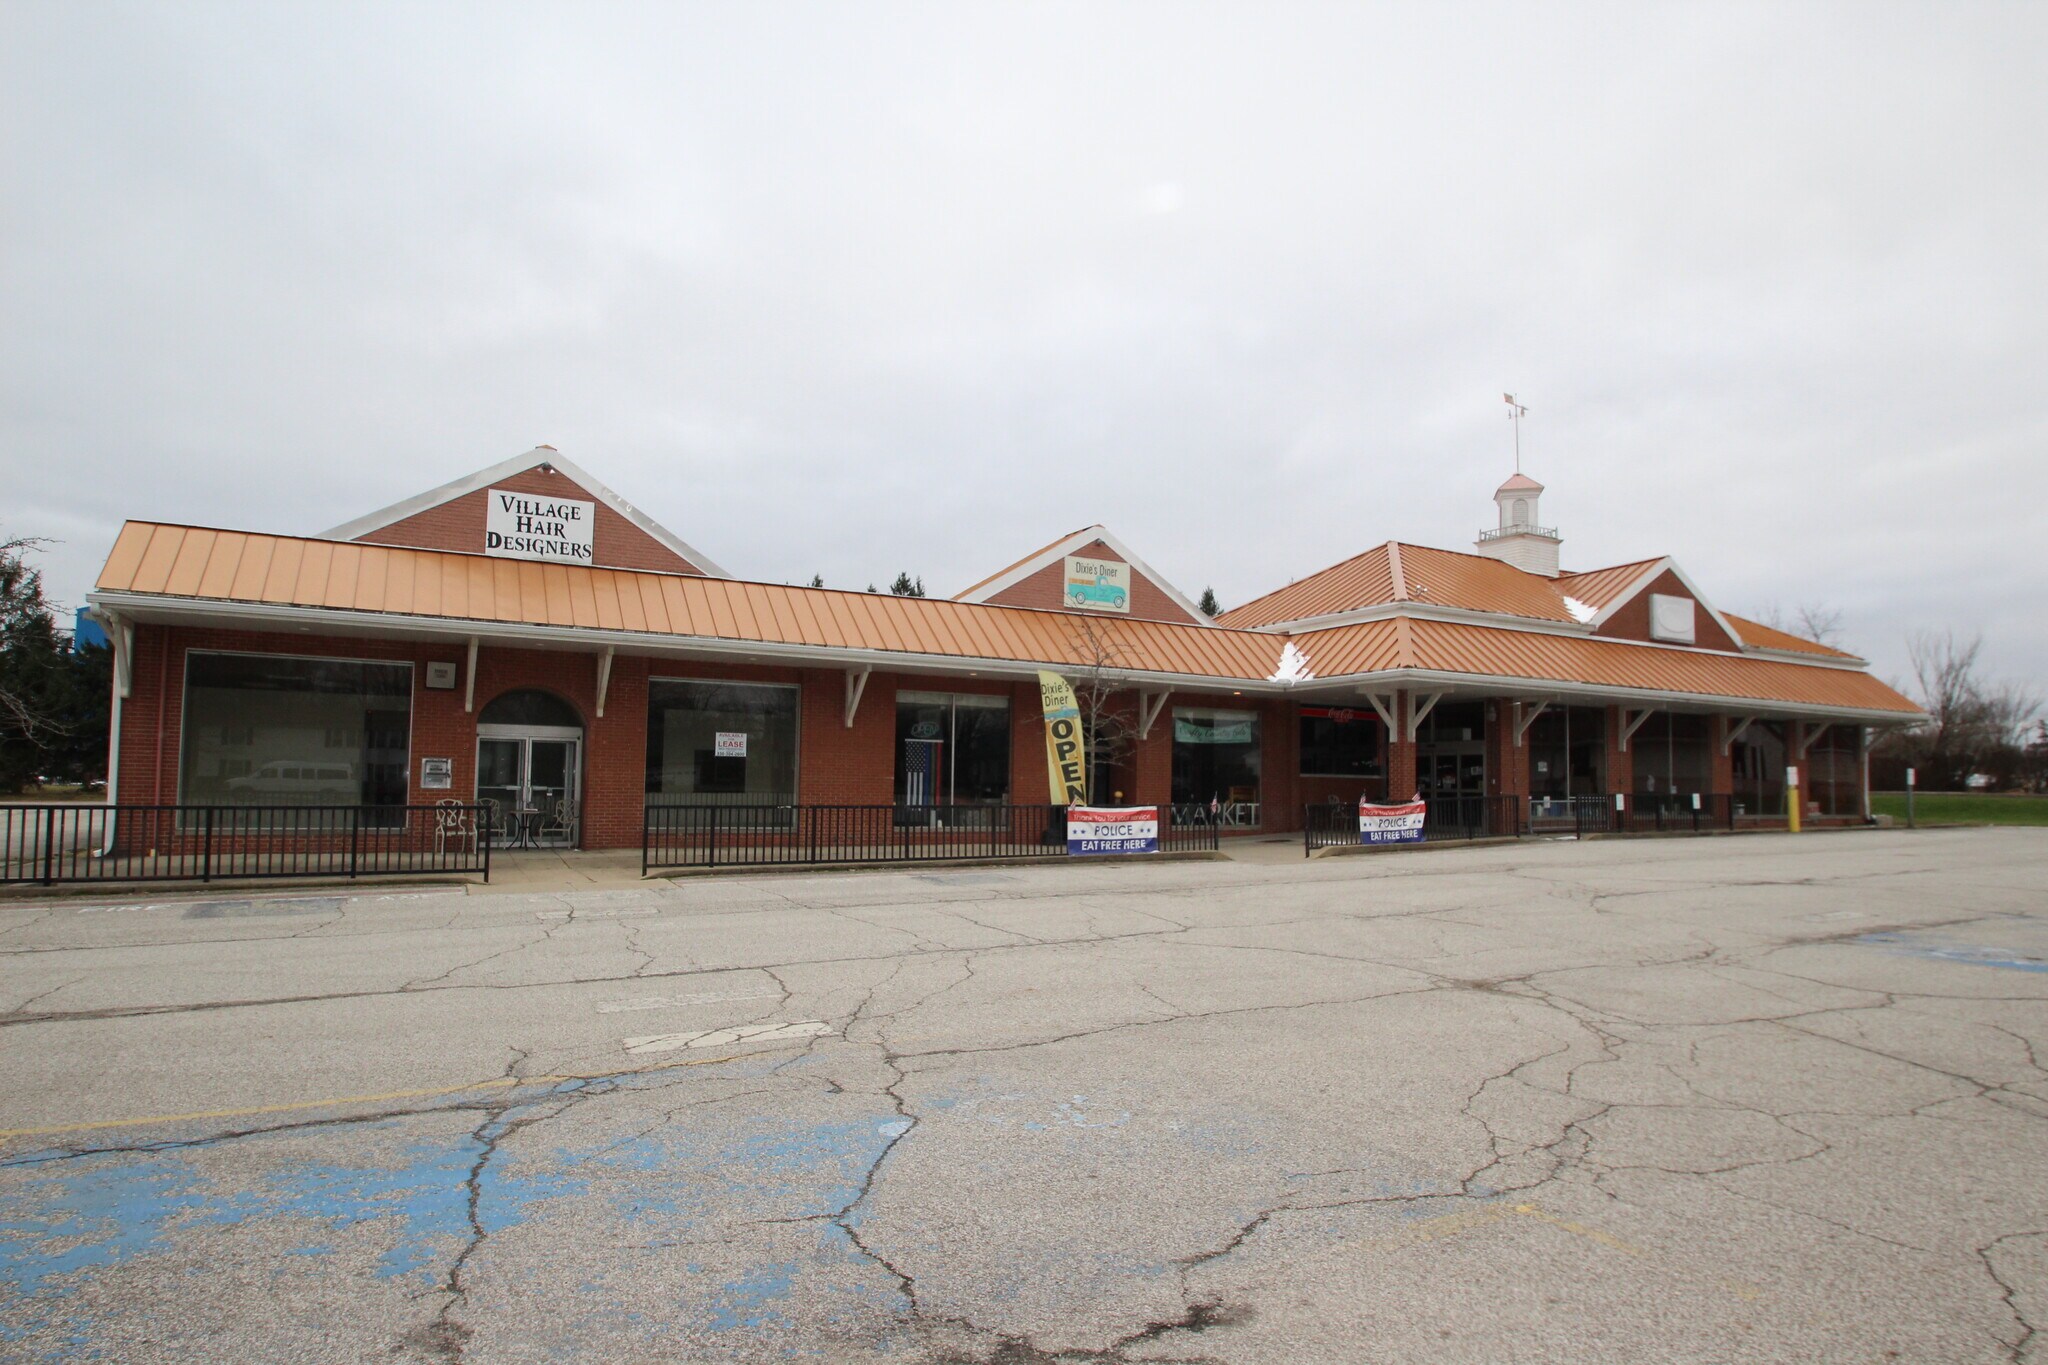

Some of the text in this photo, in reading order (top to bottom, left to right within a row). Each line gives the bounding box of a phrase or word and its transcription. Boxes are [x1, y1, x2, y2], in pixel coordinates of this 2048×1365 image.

[500, 495, 581, 522] VILLAGE
[516, 516, 567, 540] HAIR
[487, 531, 592, 559] DESIGNERS
[1075, 561, 1118, 578] Dixie's Diner
[1041, 682, 1070, 696] Dixie's
[1044, 695, 1069, 707] Diner
[1051, 719, 1086, 806] OPEN
[1378, 817, 1407, 828] POLICE
[1094, 825, 1133, 836] POLICE
[1370, 829, 1418, 841] EAT FREE HERE
[1081, 839, 1146, 851] EAT FREE HERE
